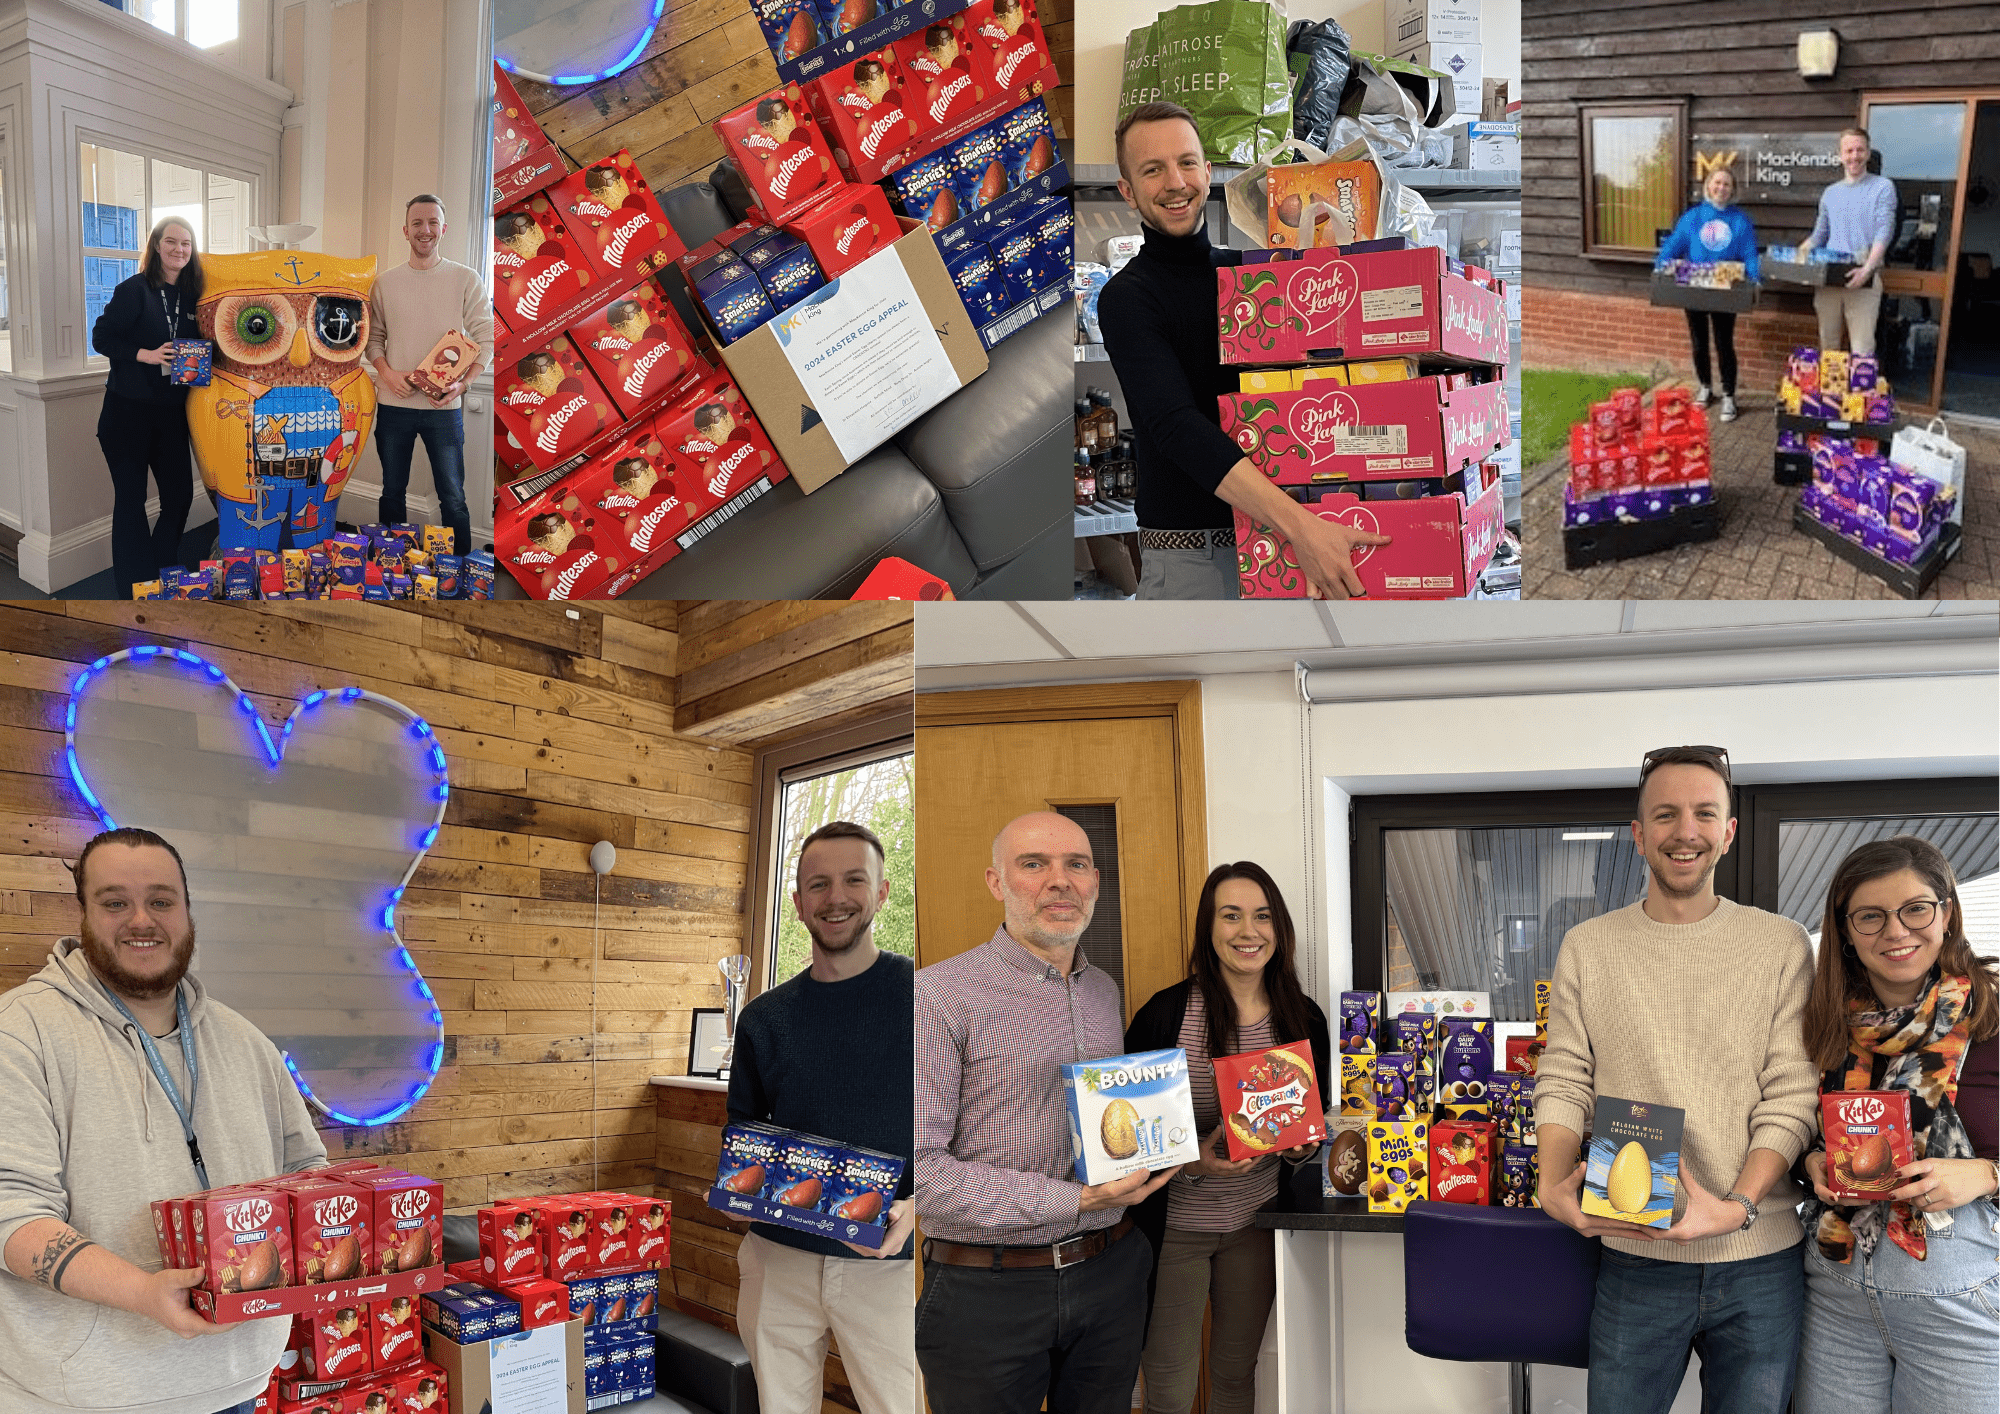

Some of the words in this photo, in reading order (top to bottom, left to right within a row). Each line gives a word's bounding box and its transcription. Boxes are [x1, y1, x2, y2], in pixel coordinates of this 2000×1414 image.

[859, 33, 877, 46] Filled
[876, 27, 891, 38] with
[983, 23, 1010, 42] Maltes
[915, 57, 943, 75] Maltes
[995, 41, 1036, 90] Maltesers
[1174, 72, 1234, 94] SLEEP.
[844, 93, 873, 110] Maltes
[929, 74, 973, 124] Maltesers
[1120, 88, 1161, 108] SLEEP
[859, 108, 905, 160] Maltesers
[1479, 124, 1514, 132] SENSODYNE
[748, 134, 779, 151] Maltes
[1756, 151, 1841, 167] MacKenzie
[769, 146, 815, 200] Maltesers
[1756, 167, 1791, 186] King
[577, 201, 612, 218] Maltes
[602, 212, 651, 268] Maltesers
[836, 216, 869, 256] Maltesers
[515, 259, 572, 321] Maltesers
[1298, 267, 1345, 302] Pink
[1305, 286, 1348, 316] Lady
[807, 308, 822, 320] King
[1445, 294, 1466, 332] Pink
[525, 325, 547, 340] HOLLOW
[546, 319, 558, 328] MILK
[804, 354, 826, 372] 2024
[825, 332, 858, 357] EASTER
[857, 319, 877, 337] EGG
[878, 299, 909, 323] APPEAL
[598, 336, 633, 351] Maltes
[623, 341, 672, 398] Maltesers
[509, 390, 546, 406] Maltes
[536, 394, 589, 454] Maltesers
[1301, 398, 1345, 433] Pink
[1447, 416, 1467, 456] Pink
[686, 439, 719, 454] Maltes
[707, 442, 756, 499] Maltesers
[604, 495, 640, 510] Maltes
[629, 495, 681, 553] Maltesers
[430, 545, 447, 553] eggs
[520, 551, 557, 565] Maltes
[1100, 1061, 1180, 1091] BOUNTY
[1343, 1063, 1359, 1072] Mini
[1844, 1098, 1883, 1124] KitKat
[1610, 1127, 1648, 1139] CHOCOLATE
[1611, 1121, 1640, 1131] BELGIAN
[1643, 1126, 1663, 1135] WHITE
[1847, 1126, 1877, 1134] CHUNKY
[1379, 1135, 1410, 1152] Mini
[1380, 1147, 1414, 1163] eggs
[1438, 1147, 1458, 1166] Maltes
[1436, 1174, 1478, 1198] Maltesers
[320, 1196, 357, 1225] KitKat
[395, 1190, 430, 1218] KitKat
[231, 1199, 271, 1231] KitKat
[397, 1219, 423, 1229] CHUNKY
[639, 1217, 653, 1231] Maltes
[786, 1214, 802, 1223] Filled
[802, 1218, 816, 1227] with
[235, 1231, 265, 1242] CHUNKY
[322, 1226, 350, 1237] CHUNKY
[598, 1240, 626, 1264] Maltesers
[638, 1236, 665, 1258] Maltesers
[504, 1246, 535, 1273] Maltesers
[557, 1245, 587, 1270] Maltesers
[380, 1312, 398, 1328] Maltes
[534, 1300, 557, 1320] Maltesers
[323, 1325, 343, 1341] Maltes
[380, 1329, 414, 1361] Maltesers
[324, 1342, 362, 1375] Maltesers
[509, 1366, 529, 1375] EASTER
[529, 1363, 541, 1371] EGG
[541, 1358, 560, 1367] APPEAL
